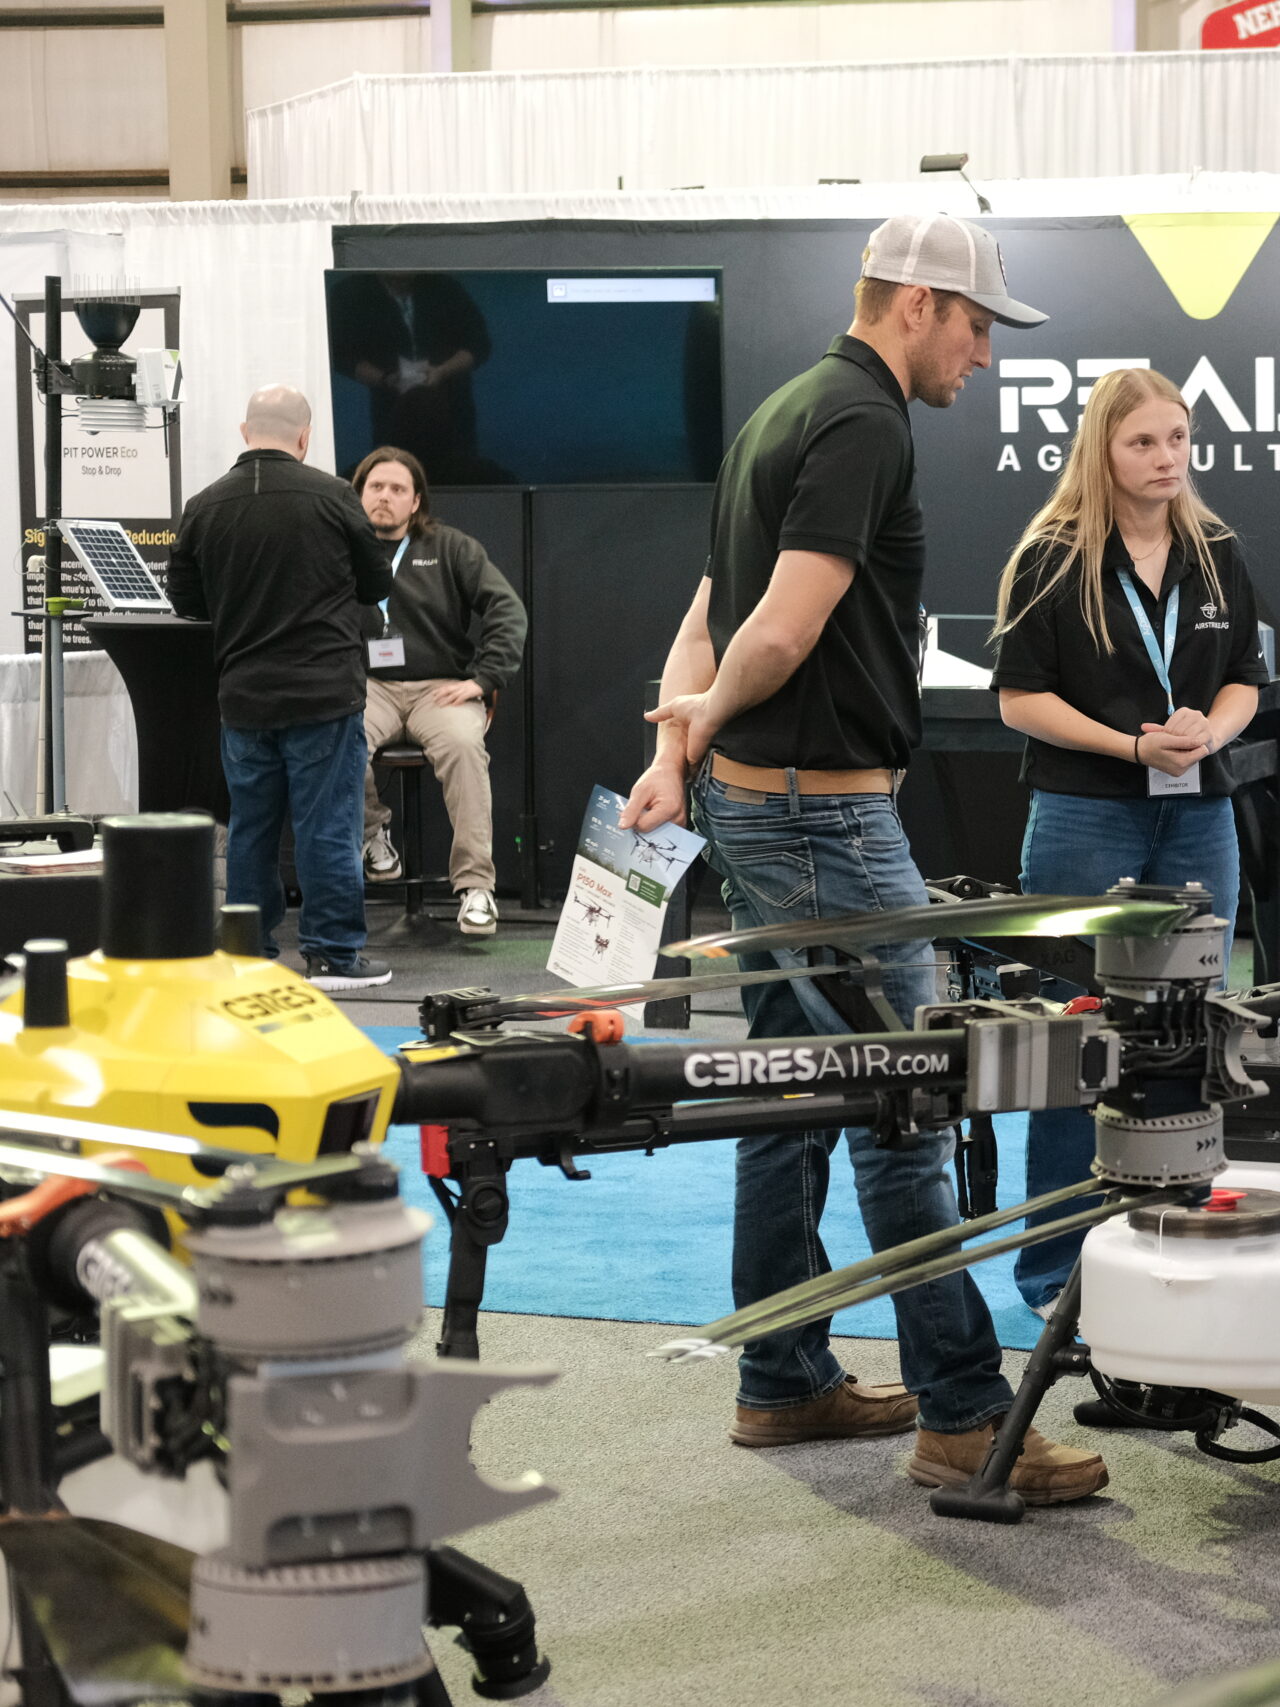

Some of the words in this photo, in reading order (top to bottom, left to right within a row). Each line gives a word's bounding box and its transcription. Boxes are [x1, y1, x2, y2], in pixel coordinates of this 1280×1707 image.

[81, 447, 118, 459] POWER
[120, 448, 138, 458] Eco
[81, 465, 97, 476] Stop
[98, 466, 104, 475] &
[105, 466, 122, 477] Drop
